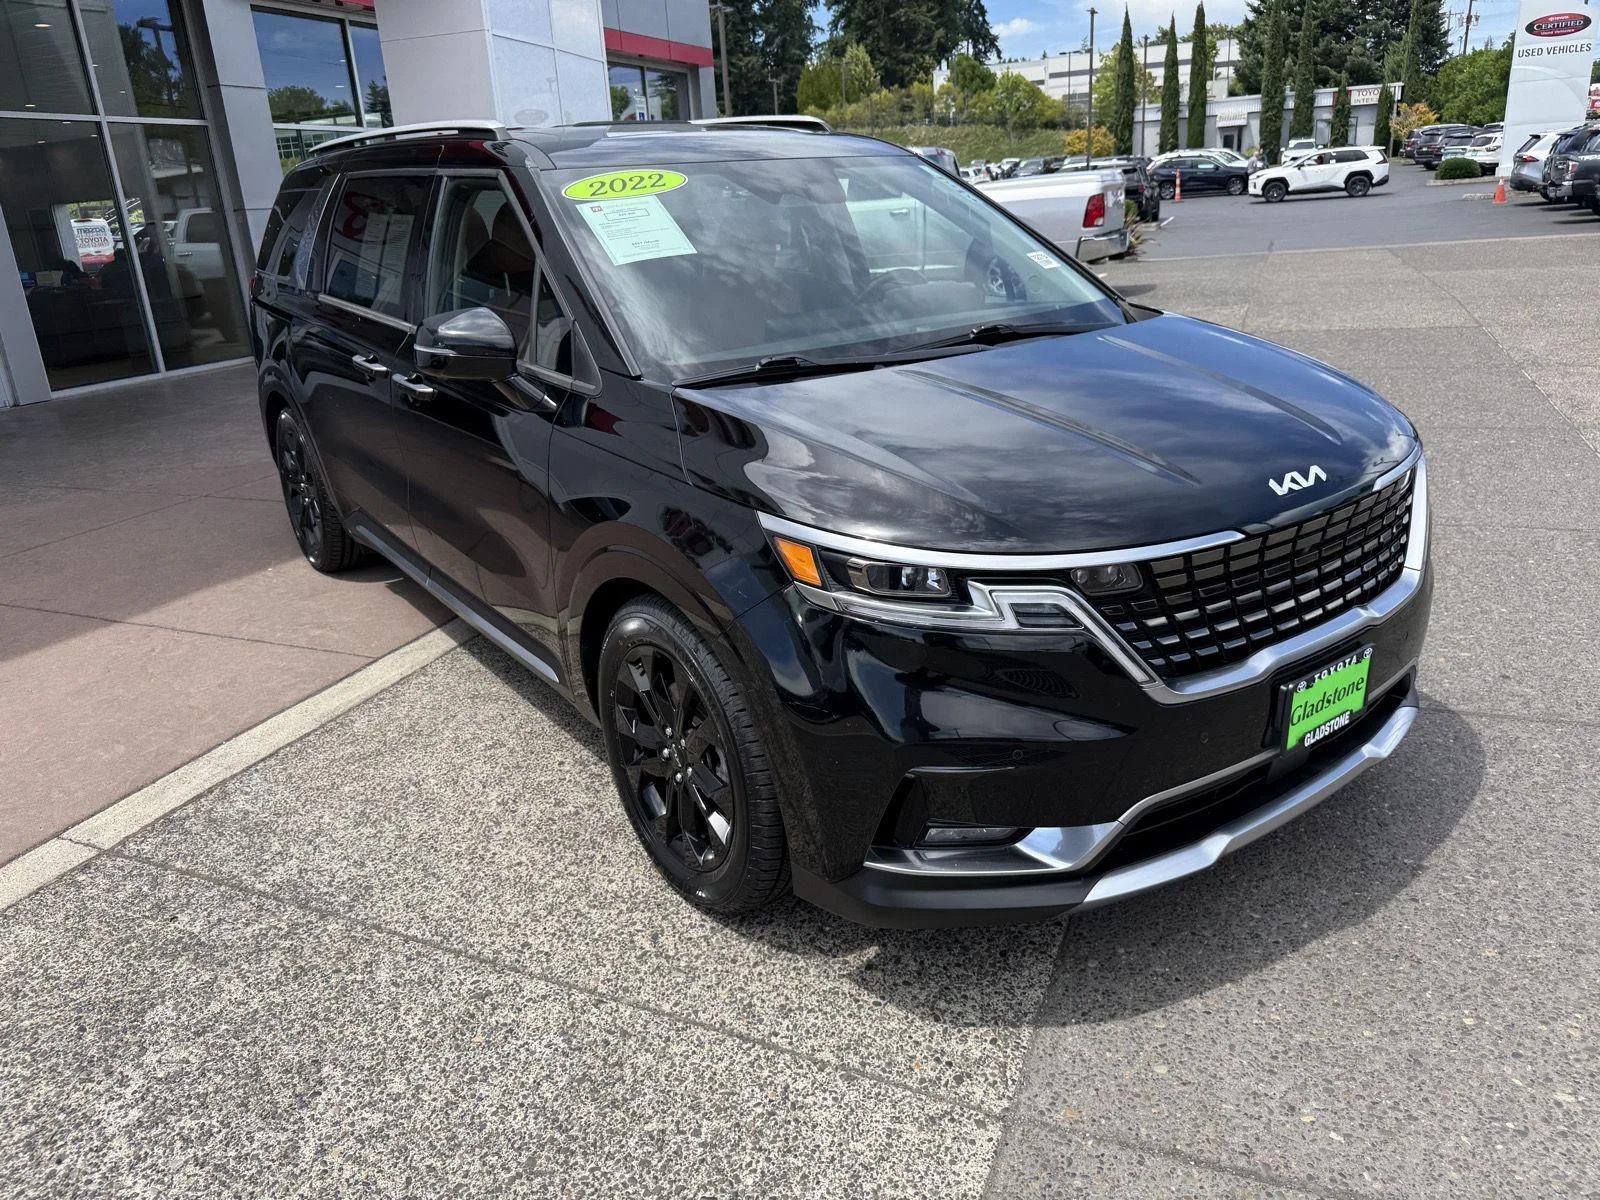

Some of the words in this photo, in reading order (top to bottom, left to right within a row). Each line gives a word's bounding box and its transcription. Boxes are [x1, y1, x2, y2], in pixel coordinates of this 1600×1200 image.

[1533, 20, 1584, 31] CERTIFIED
[1518, 47, 1544, 58] USED
[1546, 43, 1592, 56] VEHICLES
[1357, 88, 1380, 97] TOYO
[588, 173, 667, 197] 2022
[80, 236, 109, 244] TOYOTA
[1314, 655, 1358, 683] TOYOTA
[1291, 677, 1365, 727] Gladstone
[1304, 711, 1351, 747] GLADSTONE
